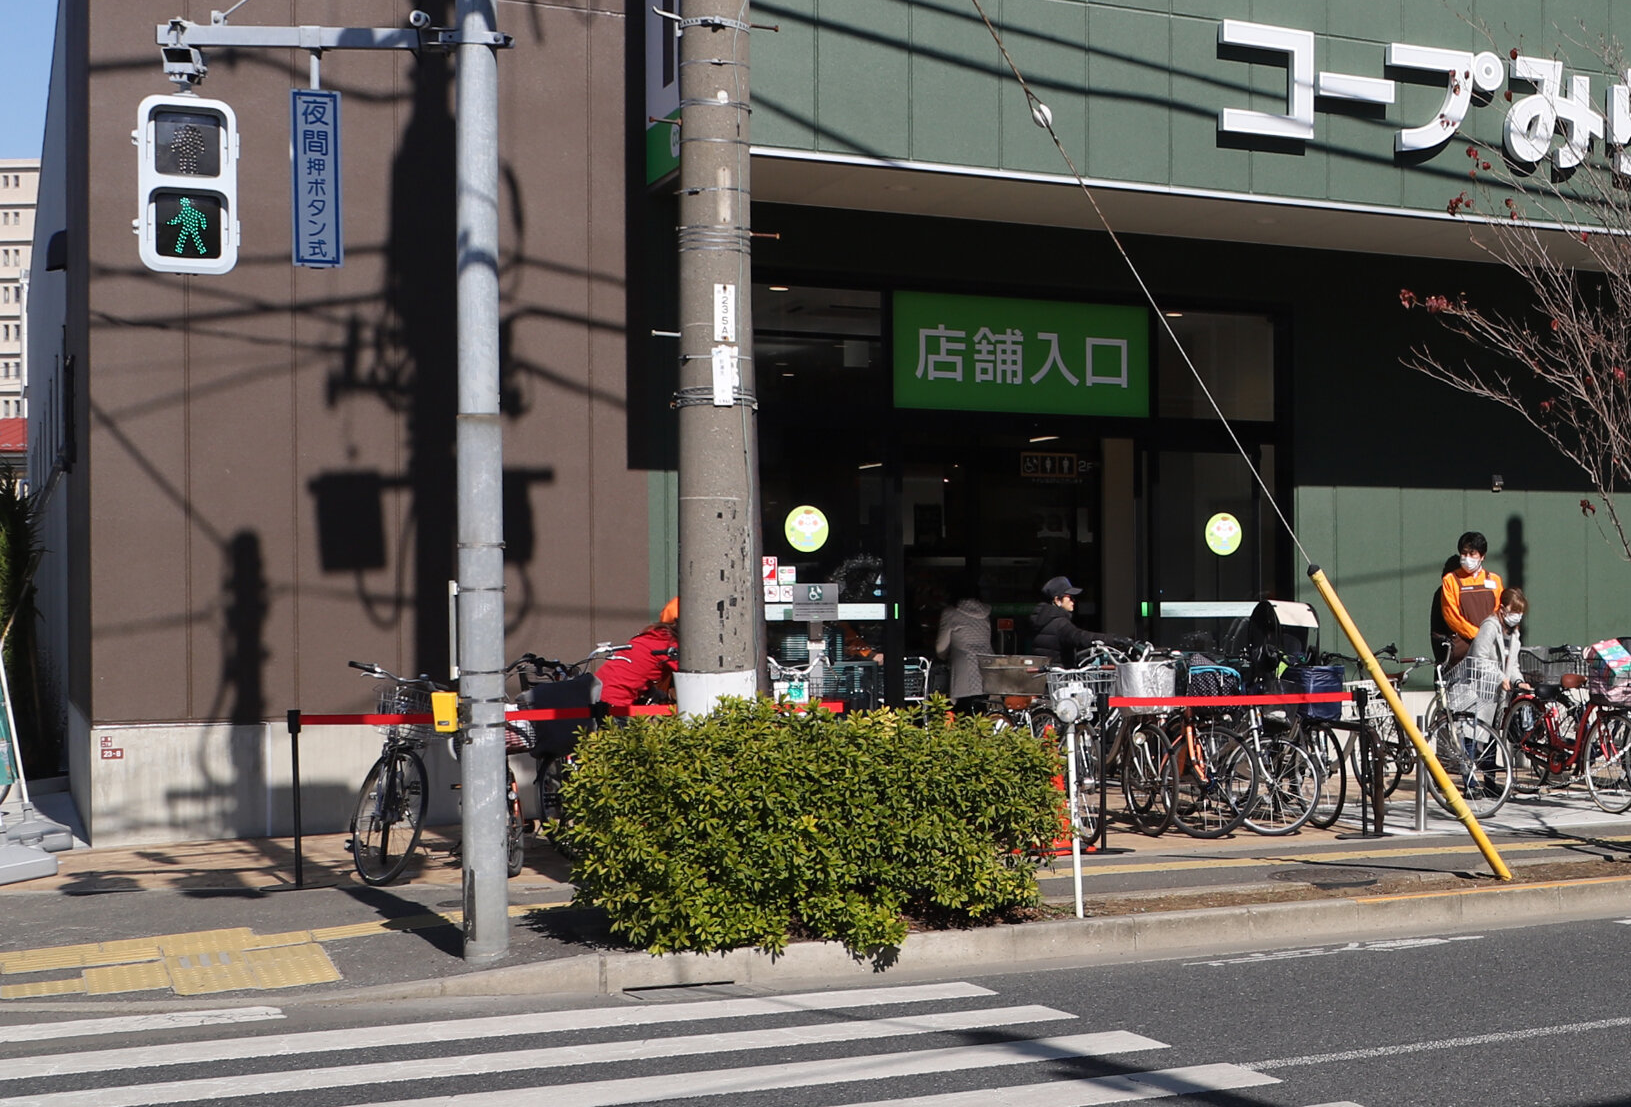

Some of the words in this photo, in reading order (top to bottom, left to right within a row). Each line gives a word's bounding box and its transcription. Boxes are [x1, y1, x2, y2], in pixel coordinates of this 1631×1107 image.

[301, 99, 330, 259] 夜間押ボタン式
[721, 296, 729, 334] 235A
[915, 324, 1129, 390] 店舗入口
